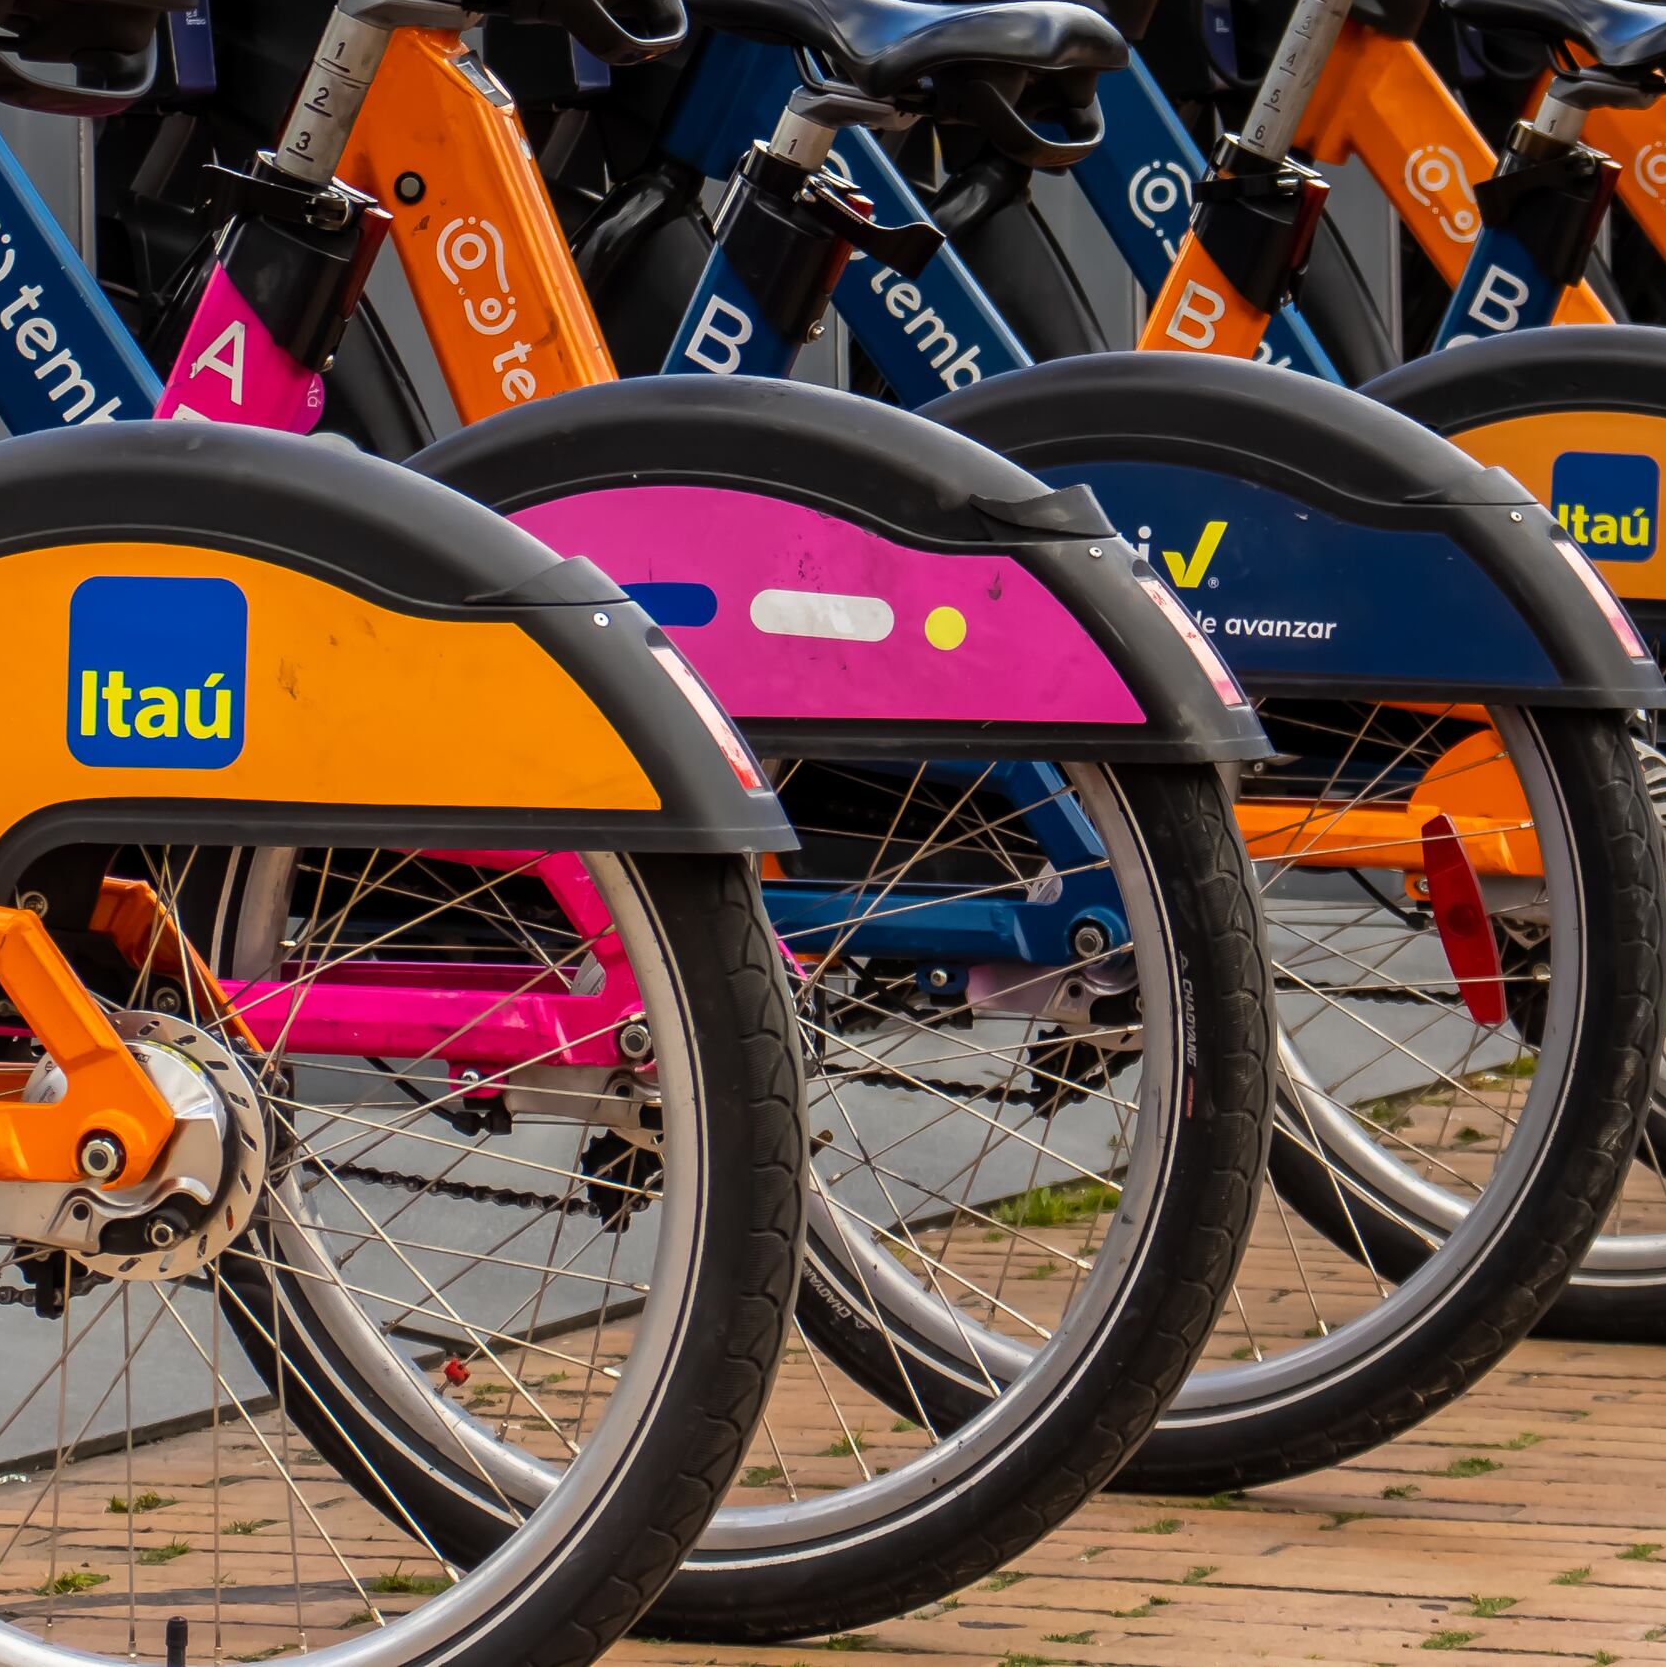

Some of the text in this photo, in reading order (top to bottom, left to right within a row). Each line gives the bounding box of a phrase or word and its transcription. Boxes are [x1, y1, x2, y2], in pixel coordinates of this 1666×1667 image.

[335, 41, 346, 60] 1
[313, 86, 330, 108] 2
[1270, 89, 1281, 104] 5
[296, 131, 312, 152] 3
[1255, 125, 1266, 140] 6
[788, 138, 798, 155] 1
[1166, 279, 1225, 349] B
[685, 294, 753, 374] B
[1558, 503, 1650, 546] Itaú
[1224, 617, 1337, 639] avanzar
[80, 670, 232, 739] Itaú
[1183, 978, 1197, 1068] CHAOYANG
[801, 1261, 853, 1320] CHAOYAN
